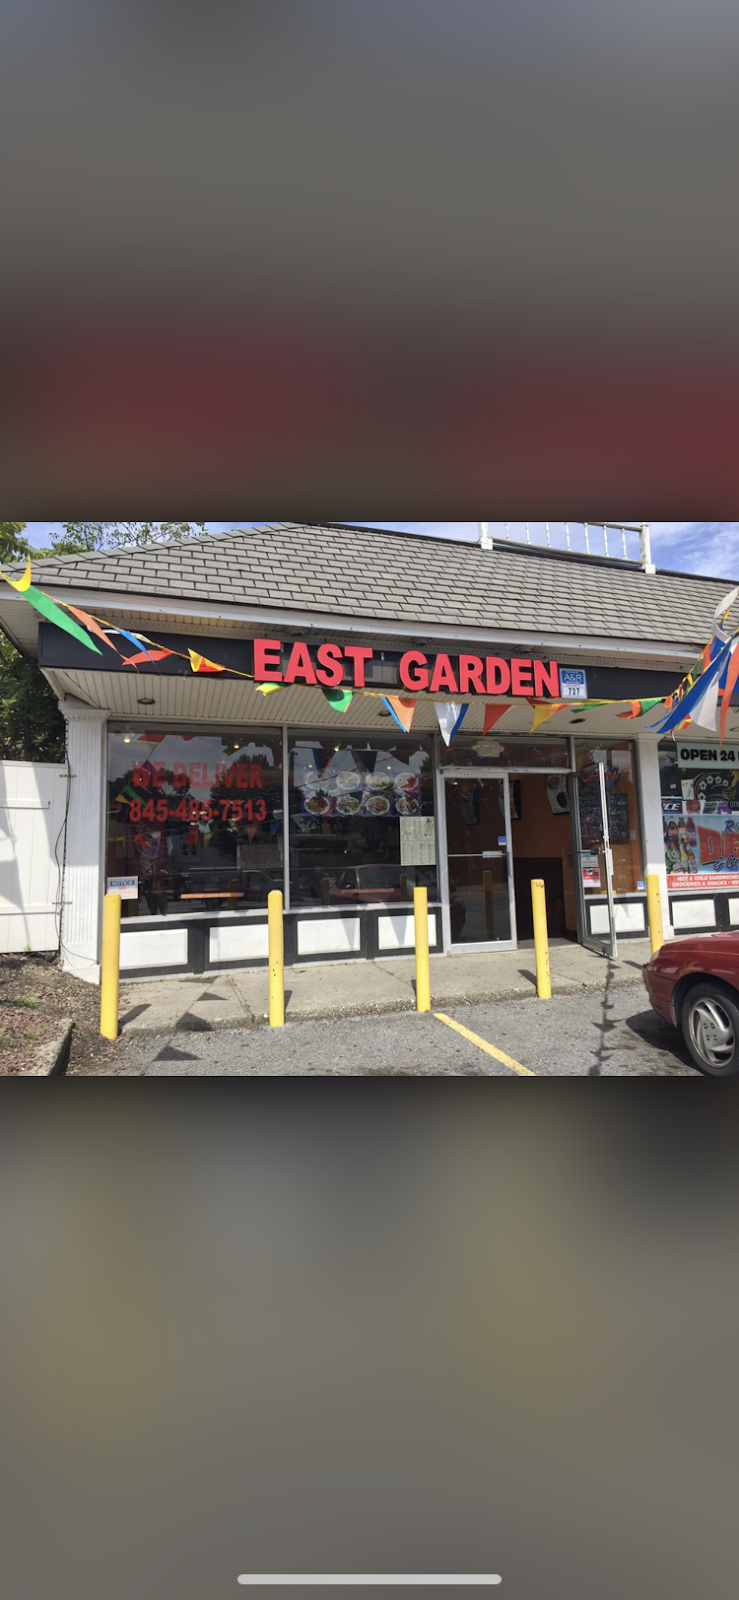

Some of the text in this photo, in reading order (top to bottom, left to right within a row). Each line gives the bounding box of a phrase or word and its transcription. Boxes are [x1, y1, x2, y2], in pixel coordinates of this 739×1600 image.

[253, 638, 561, 697] EAST GARDEN
[563, 673, 582, 681] A&R
[568, 687, 580, 696] 737
[680, 748, 736, 762] OPEN 24
[132, 761, 263, 788] WE DELIVER
[129, 799, 267, 822] 845-485-7513
